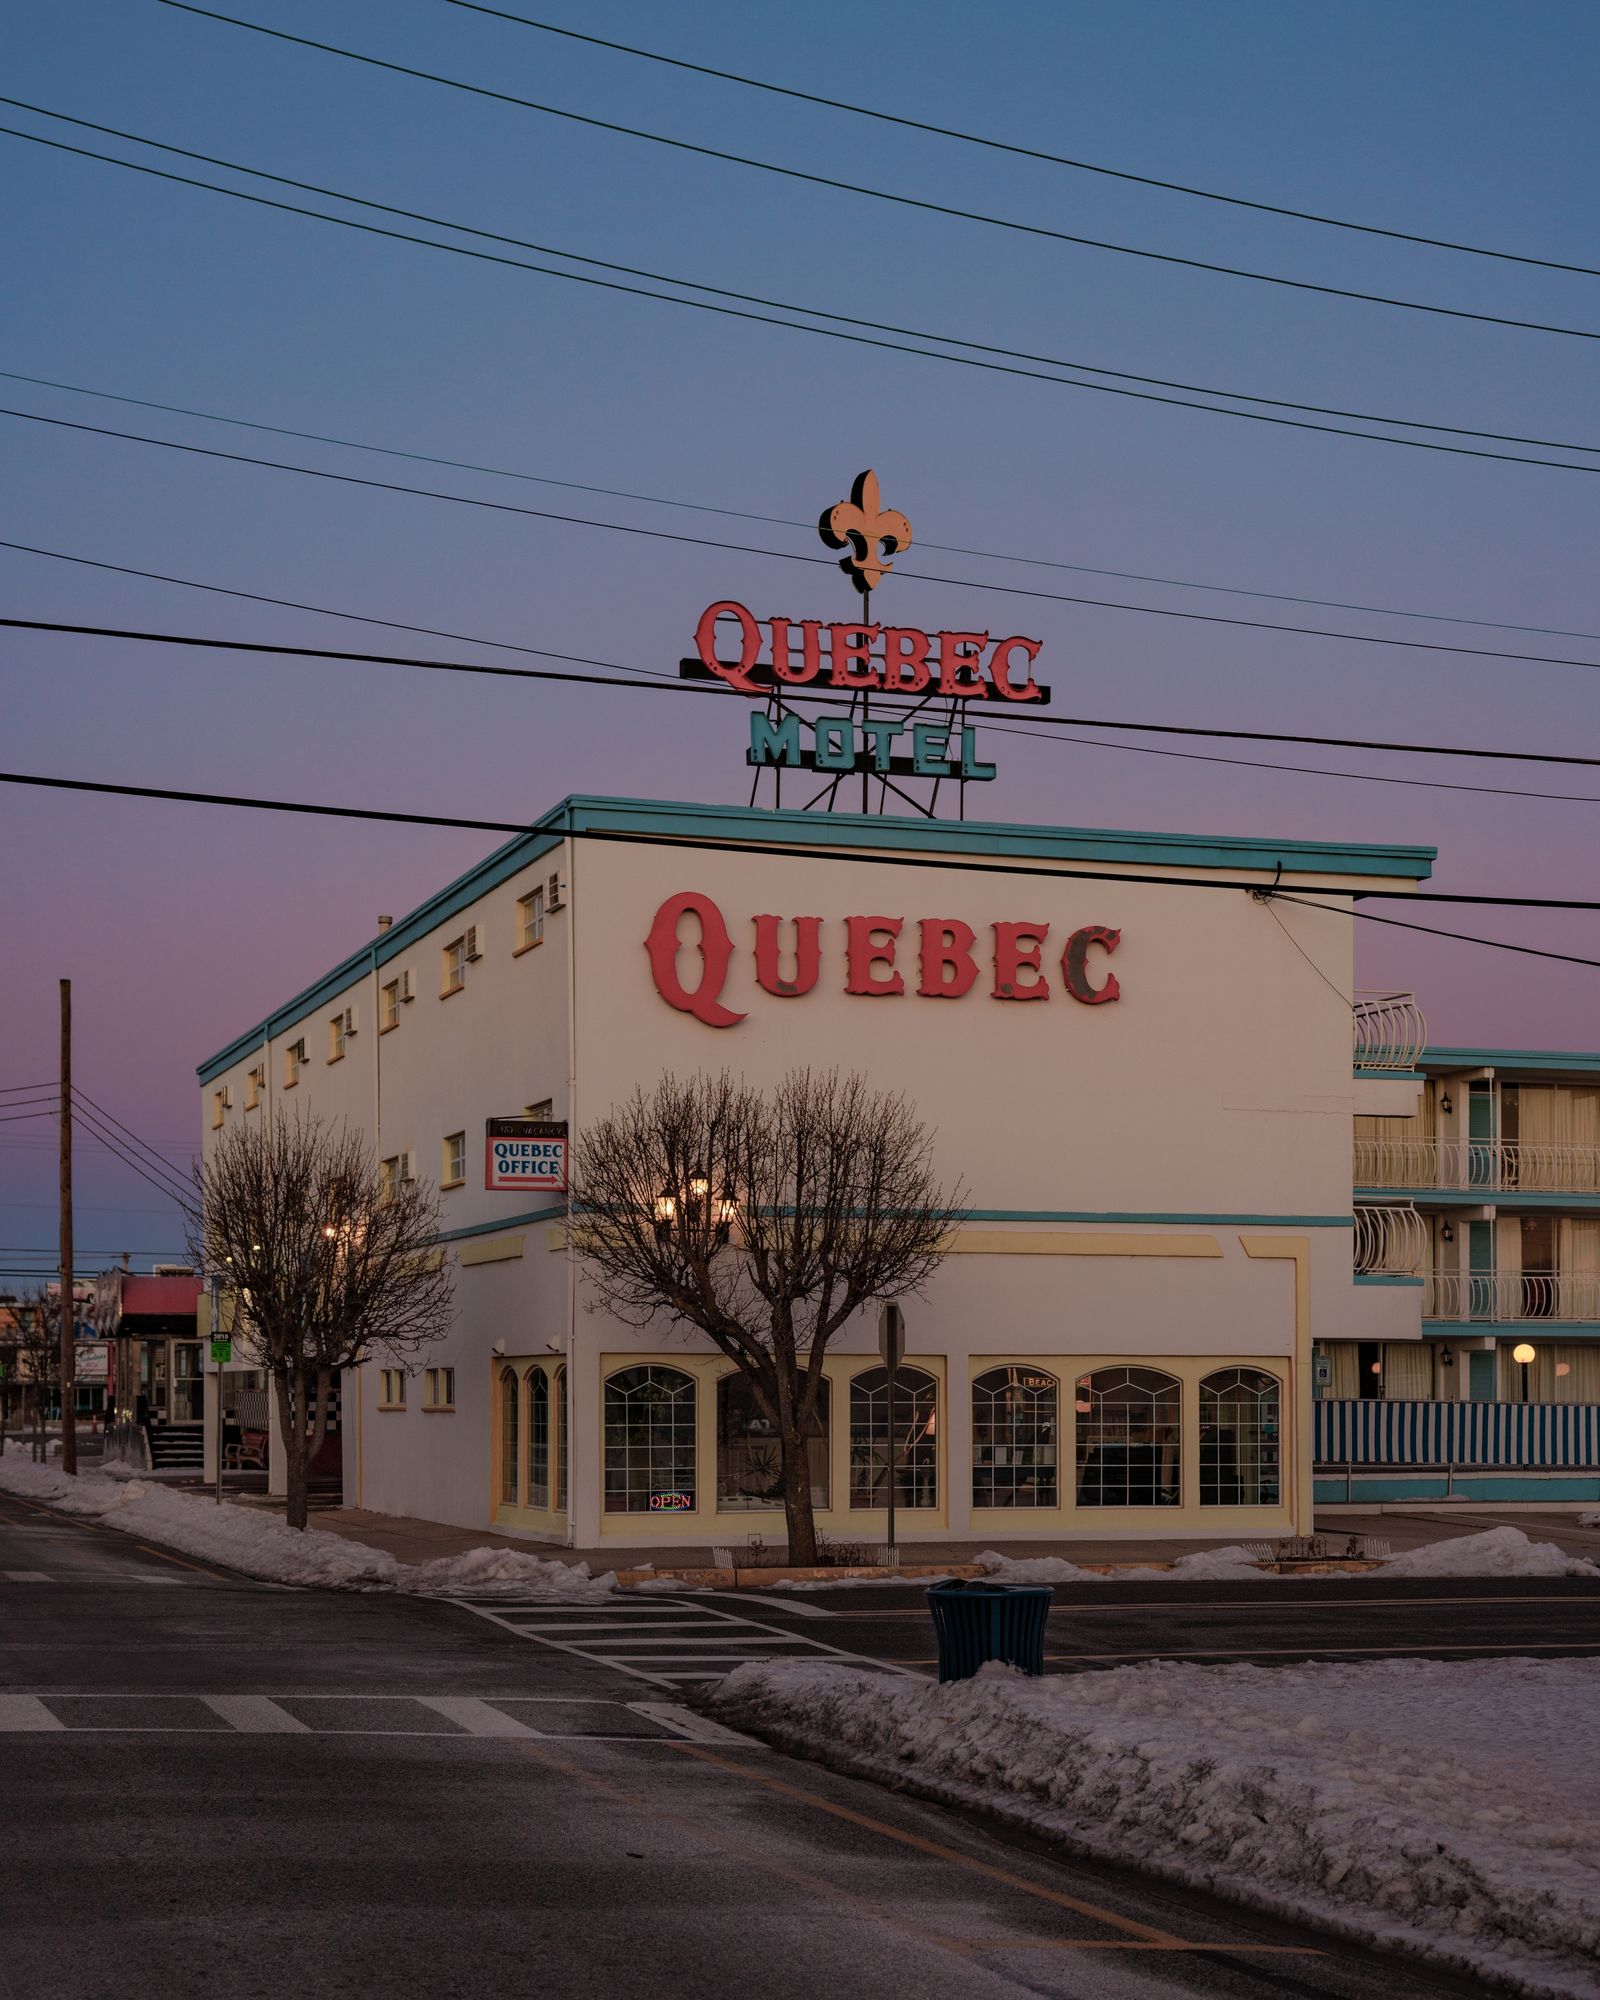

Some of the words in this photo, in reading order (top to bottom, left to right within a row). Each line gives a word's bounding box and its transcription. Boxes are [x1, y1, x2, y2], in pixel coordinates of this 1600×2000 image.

[693, 600, 1043, 699] QUEBEC
[749, 711, 996, 780] MOTEL
[643, 891, 1121, 1028] QUEBEC
[522, 1127, 562, 1135] VACANCY
[494, 1143, 562, 1158] QUEBEC
[498, 1160, 559, 1174] OFFICE
[650, 1495, 691, 1509] OPEN
